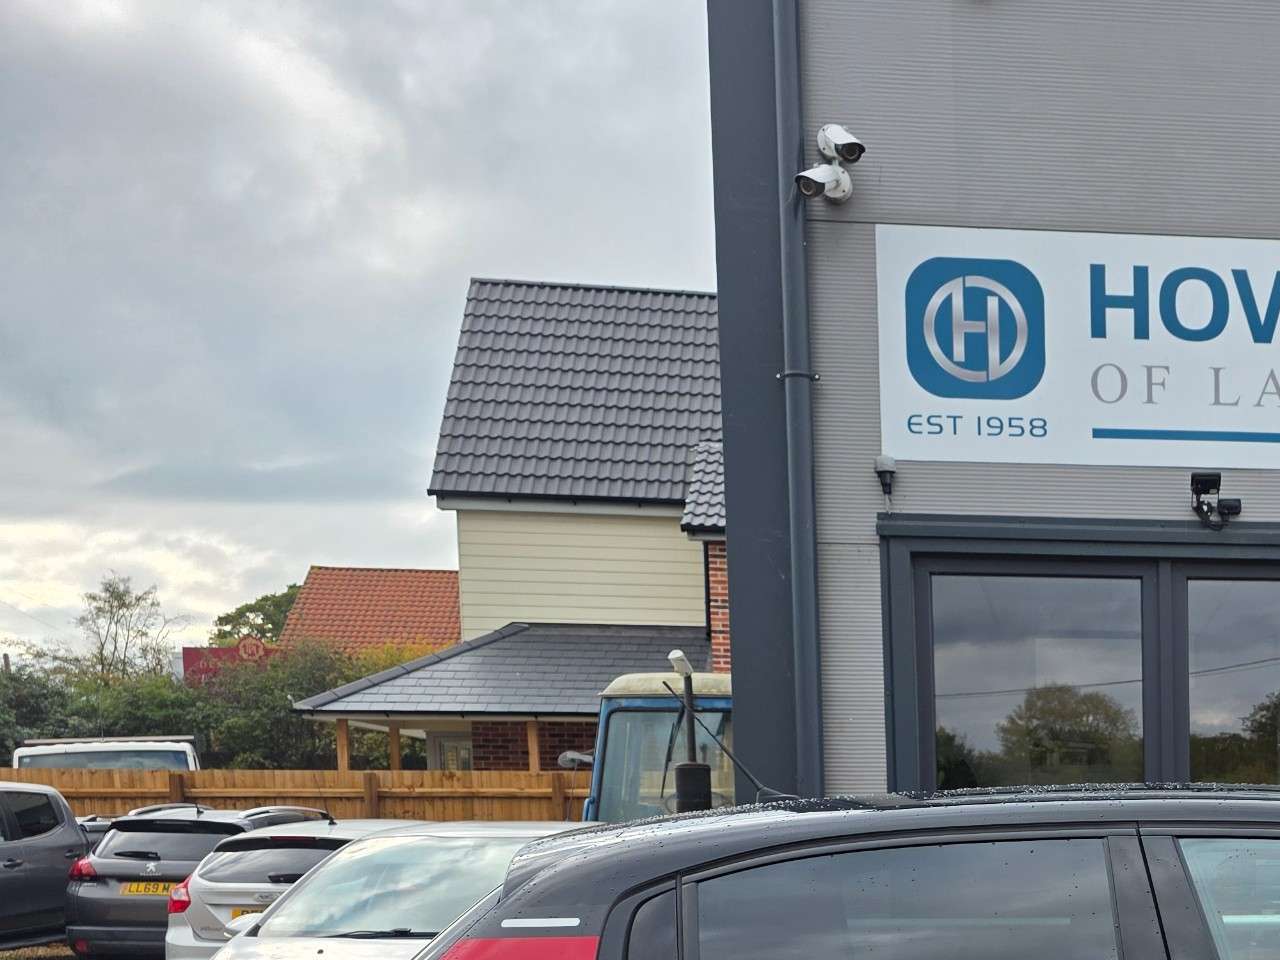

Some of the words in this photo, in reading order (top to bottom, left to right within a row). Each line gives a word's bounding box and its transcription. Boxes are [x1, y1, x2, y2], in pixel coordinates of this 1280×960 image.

[1090, 362, 1171, 404] OF
[907, 414, 964, 436] EST
[977, 415, 1048, 438] 1958
[128, 882, 160, 894] LL69
